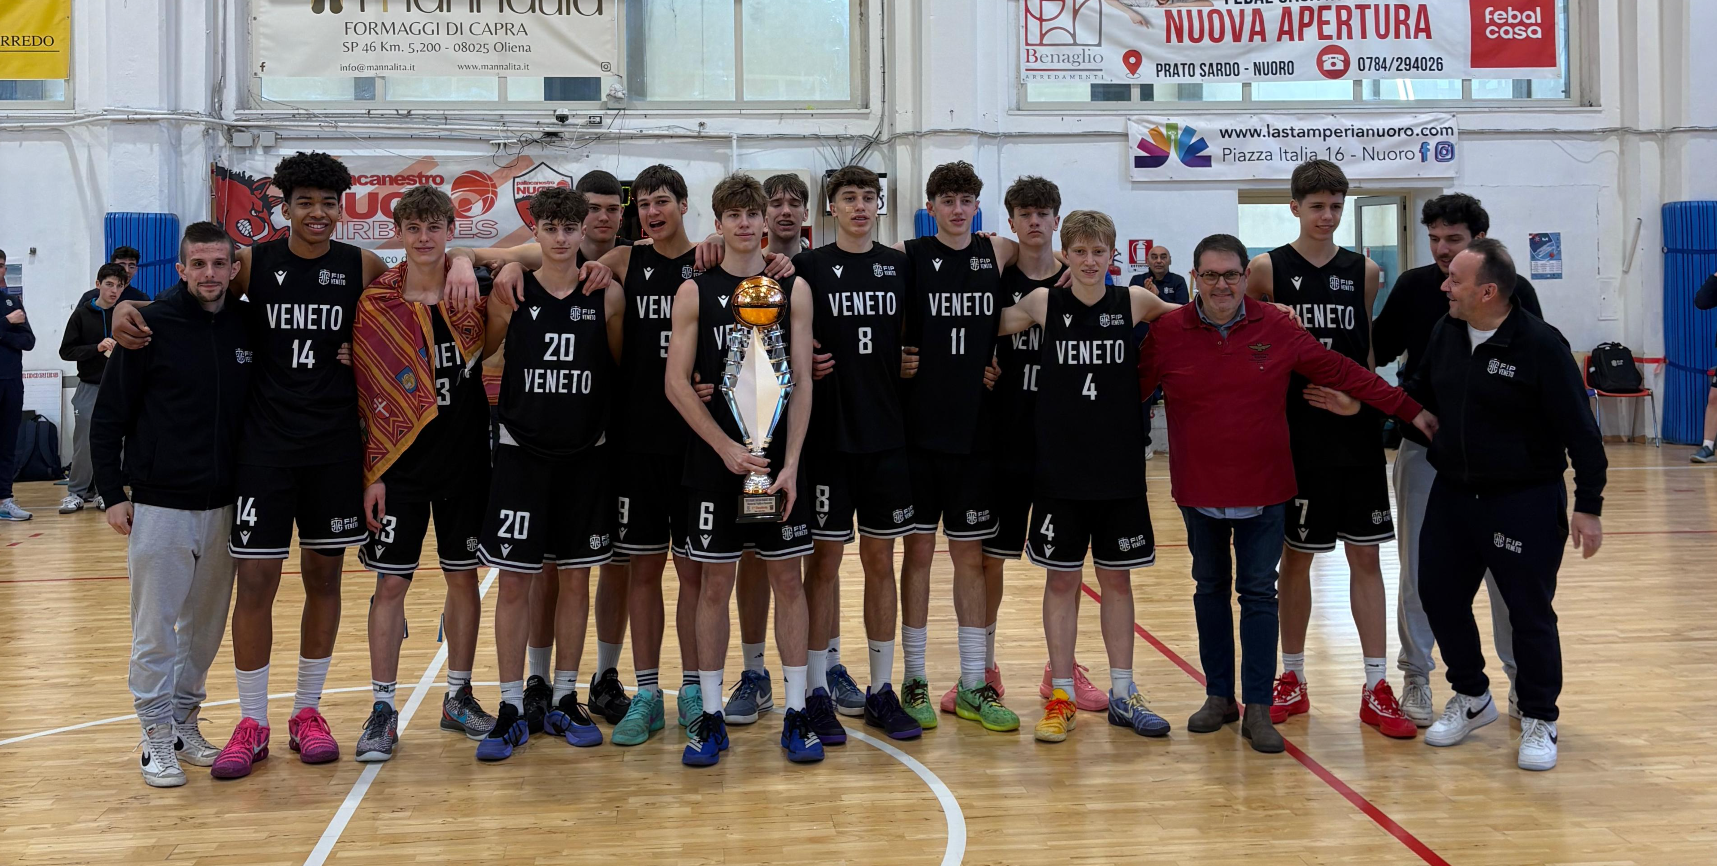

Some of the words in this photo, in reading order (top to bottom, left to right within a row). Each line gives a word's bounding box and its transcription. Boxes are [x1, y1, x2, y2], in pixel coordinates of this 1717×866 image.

[1164, 8, 1267, 43] NUOVA
[1276, 4, 1432, 42] APERTURA
[1485, 6, 1542, 24] febal
[344, 22, 440, 36] FORMAGGI
[446, 22, 463, 36] DI
[469, 22, 529, 36] CAPRA
[1486, 25, 1542, 39] casa
[342, 41, 359, 53] SP
[362, 41, 377, 54] 46
[381, 41, 404, 53] Km.
[408, 42, 441, 54] 5,200
[453, 42, 490, 54] 08025
[493, 41, 532, 53] Oliena
[1025, 48, 1104, 67] Benaglio
[339, 63, 416, 73] info@mannalita.it
[457, 62, 530, 71] www.mannalita.it
[1156, 62, 1196, 78] PRATO
[1200, 62, 1240, 78] SARDO
[1253, 60, 1295, 76] NUORO
[1357, 56, 1444, 72] 0784/294026
[1219, 123, 1454, 142] www.lastamperianuoro.com
[1222, 146, 1273, 163] Piazza
[1279, 145, 1318, 163] Italia
[1325, 146, 1345, 162] 16
[1362, 145, 1416, 162] Nuoro
[350, 171, 445, 187] canestro
[266, 303, 343, 331] VENETO
[636, 295, 676, 319] VEN
[828, 291, 897, 317] VENETO
[928, 292, 994, 317] VENETO
[543, 332, 576, 362] 20
[858, 326, 873, 355] 8
[950, 327, 966, 355] 11
[1011, 327, 1040, 351] VEN
[1055, 339, 1125, 365] VENETO
[291, 339, 316, 369] 14
[523, 368, 592, 394] VENETO
[1081, 372, 1098, 401] 4
[236, 495, 258, 527] 14
[618, 496, 630, 524] 9
[815, 484, 830, 513] 8
[1294, 498, 1309, 525] 7
[497, 509, 531, 540] 20
[698, 501, 715, 531] 6
[1040, 513, 1055, 541] 4
